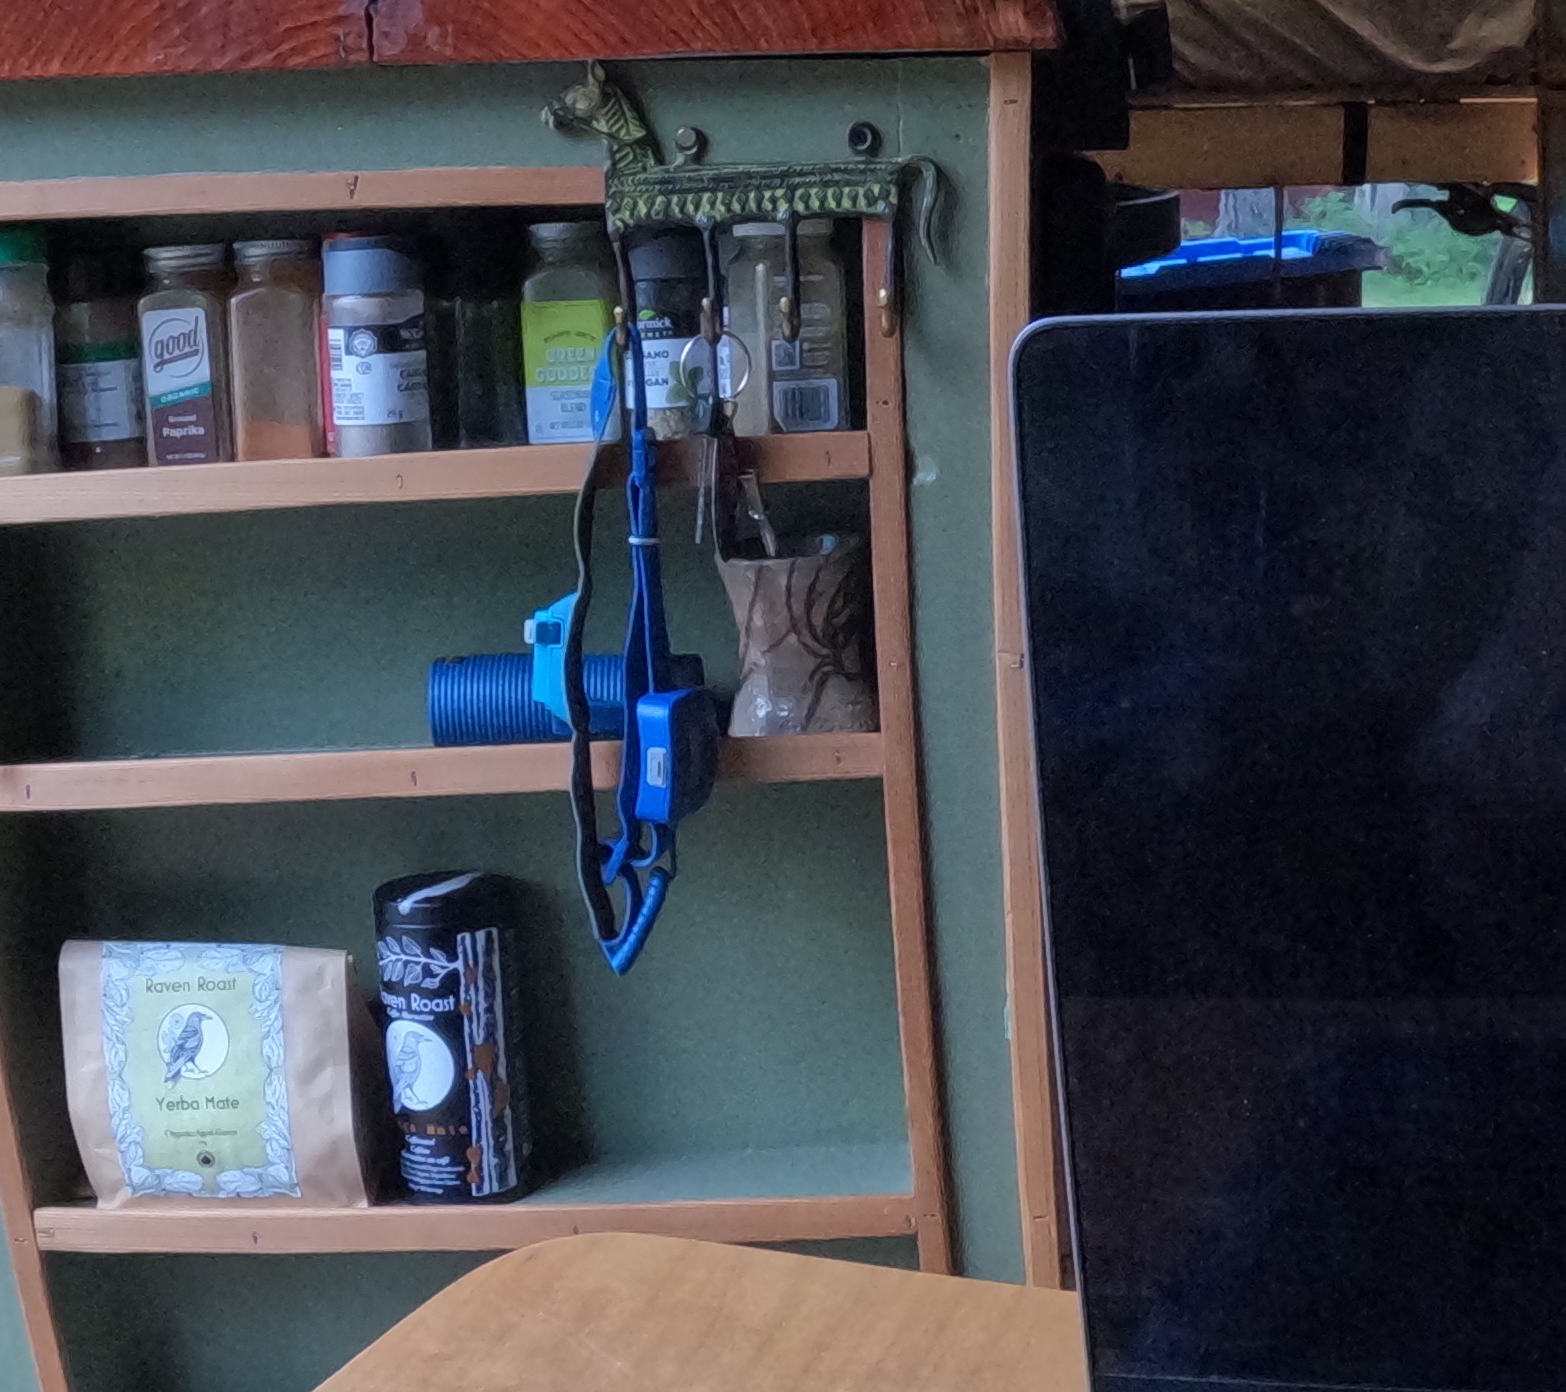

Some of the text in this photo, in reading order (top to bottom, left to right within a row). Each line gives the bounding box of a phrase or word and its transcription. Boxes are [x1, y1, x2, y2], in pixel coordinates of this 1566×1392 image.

[153, 315, 200, 374] good
[162, 425, 205, 439] Paprika
[145, 976, 237, 994] Raven Roast
[381, 991, 455, 1012] aven Roast
[155, 1095, 240, 1112] Yerba Mate
